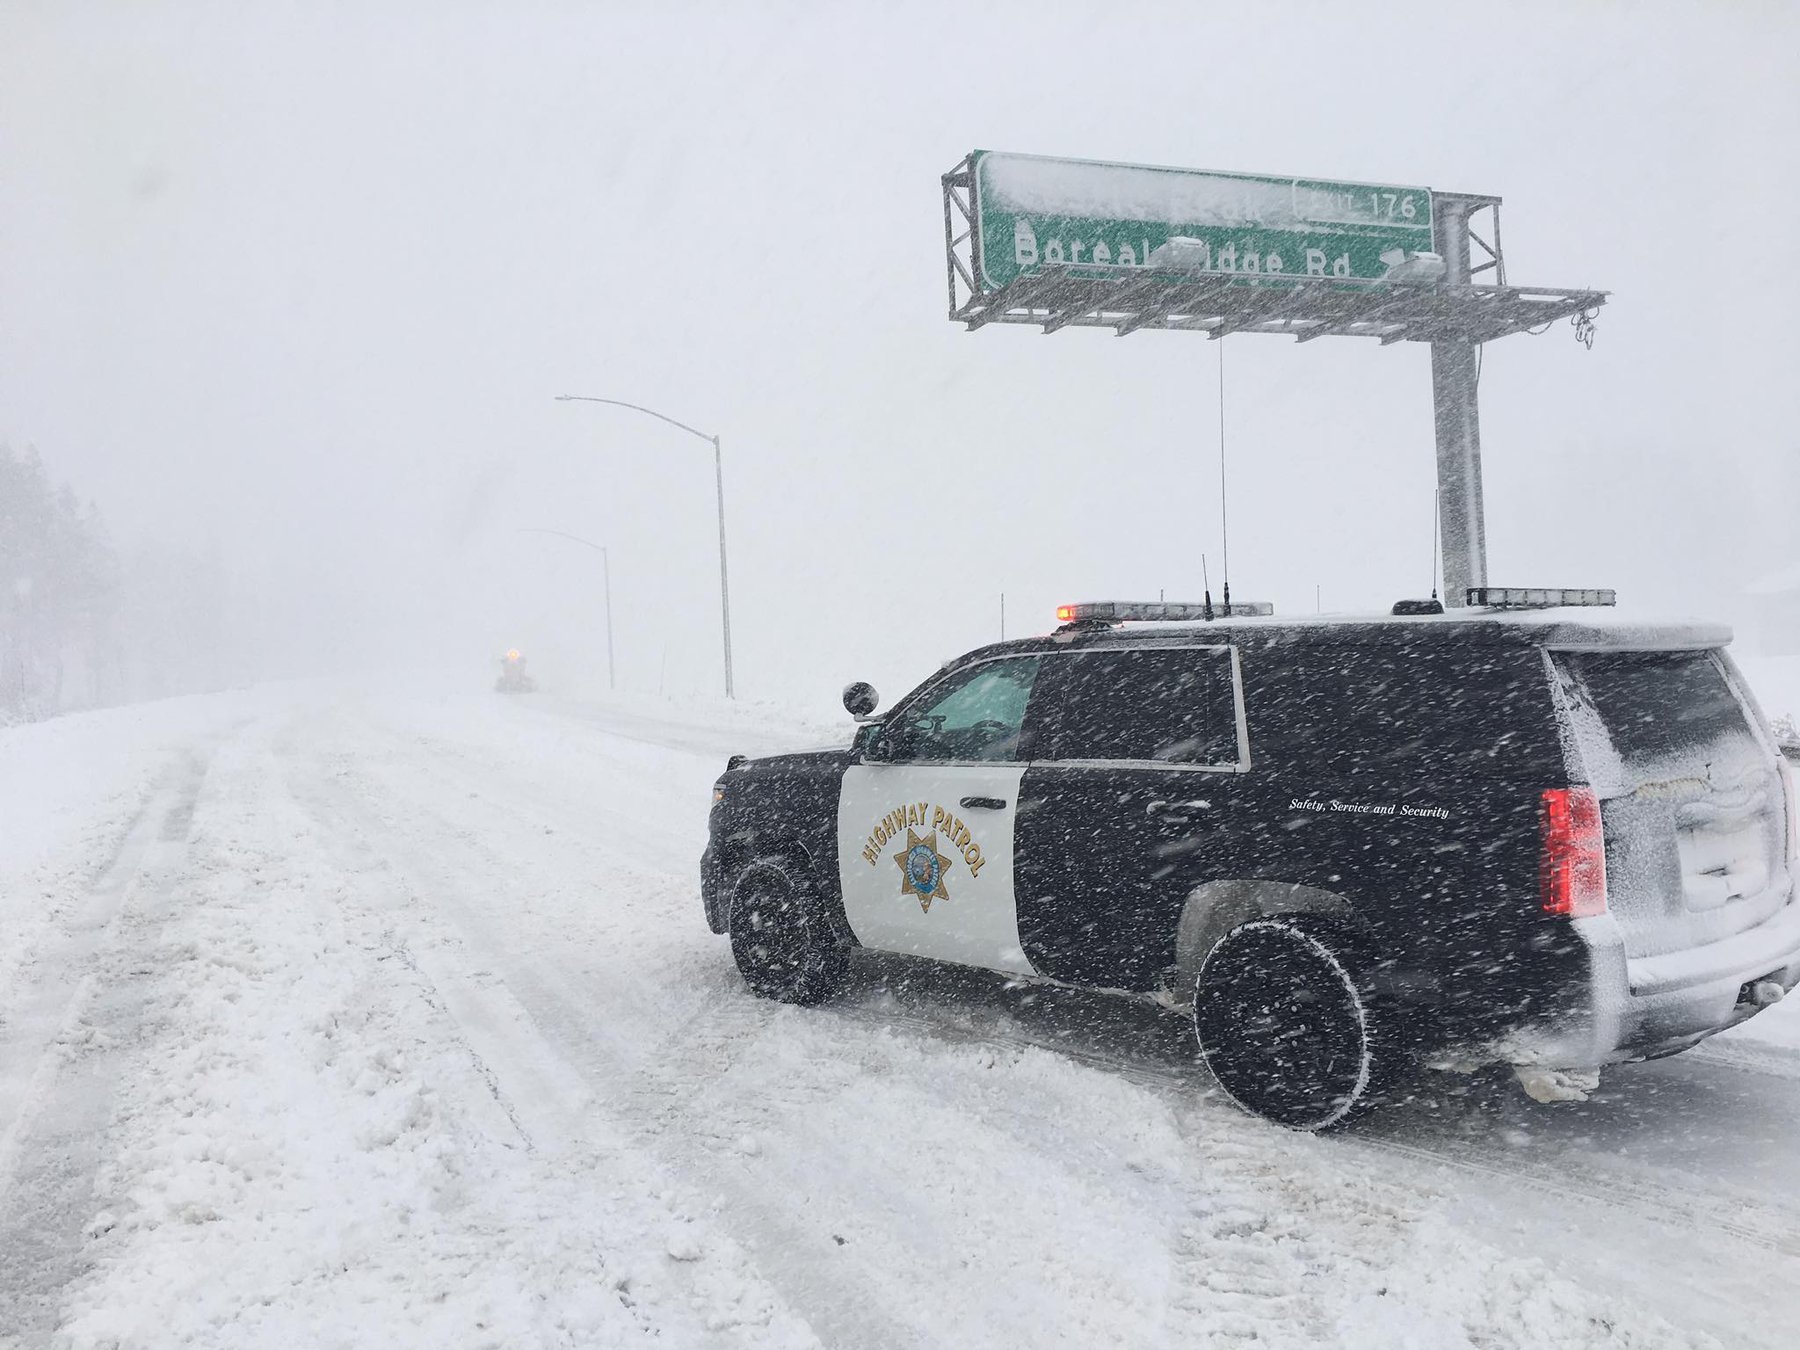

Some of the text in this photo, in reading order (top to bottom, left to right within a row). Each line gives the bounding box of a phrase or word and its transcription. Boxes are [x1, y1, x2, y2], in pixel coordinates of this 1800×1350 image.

[1371, 192, 1417, 218] 176
[1013, 222, 1150, 267] Boreal
[1306, 248, 1350, 277] Rd
[1289, 798, 1450, 819] Safety, Service and Security
[862, 802, 928, 866] HIGHWAY
[932, 805, 986, 878] PATROL
